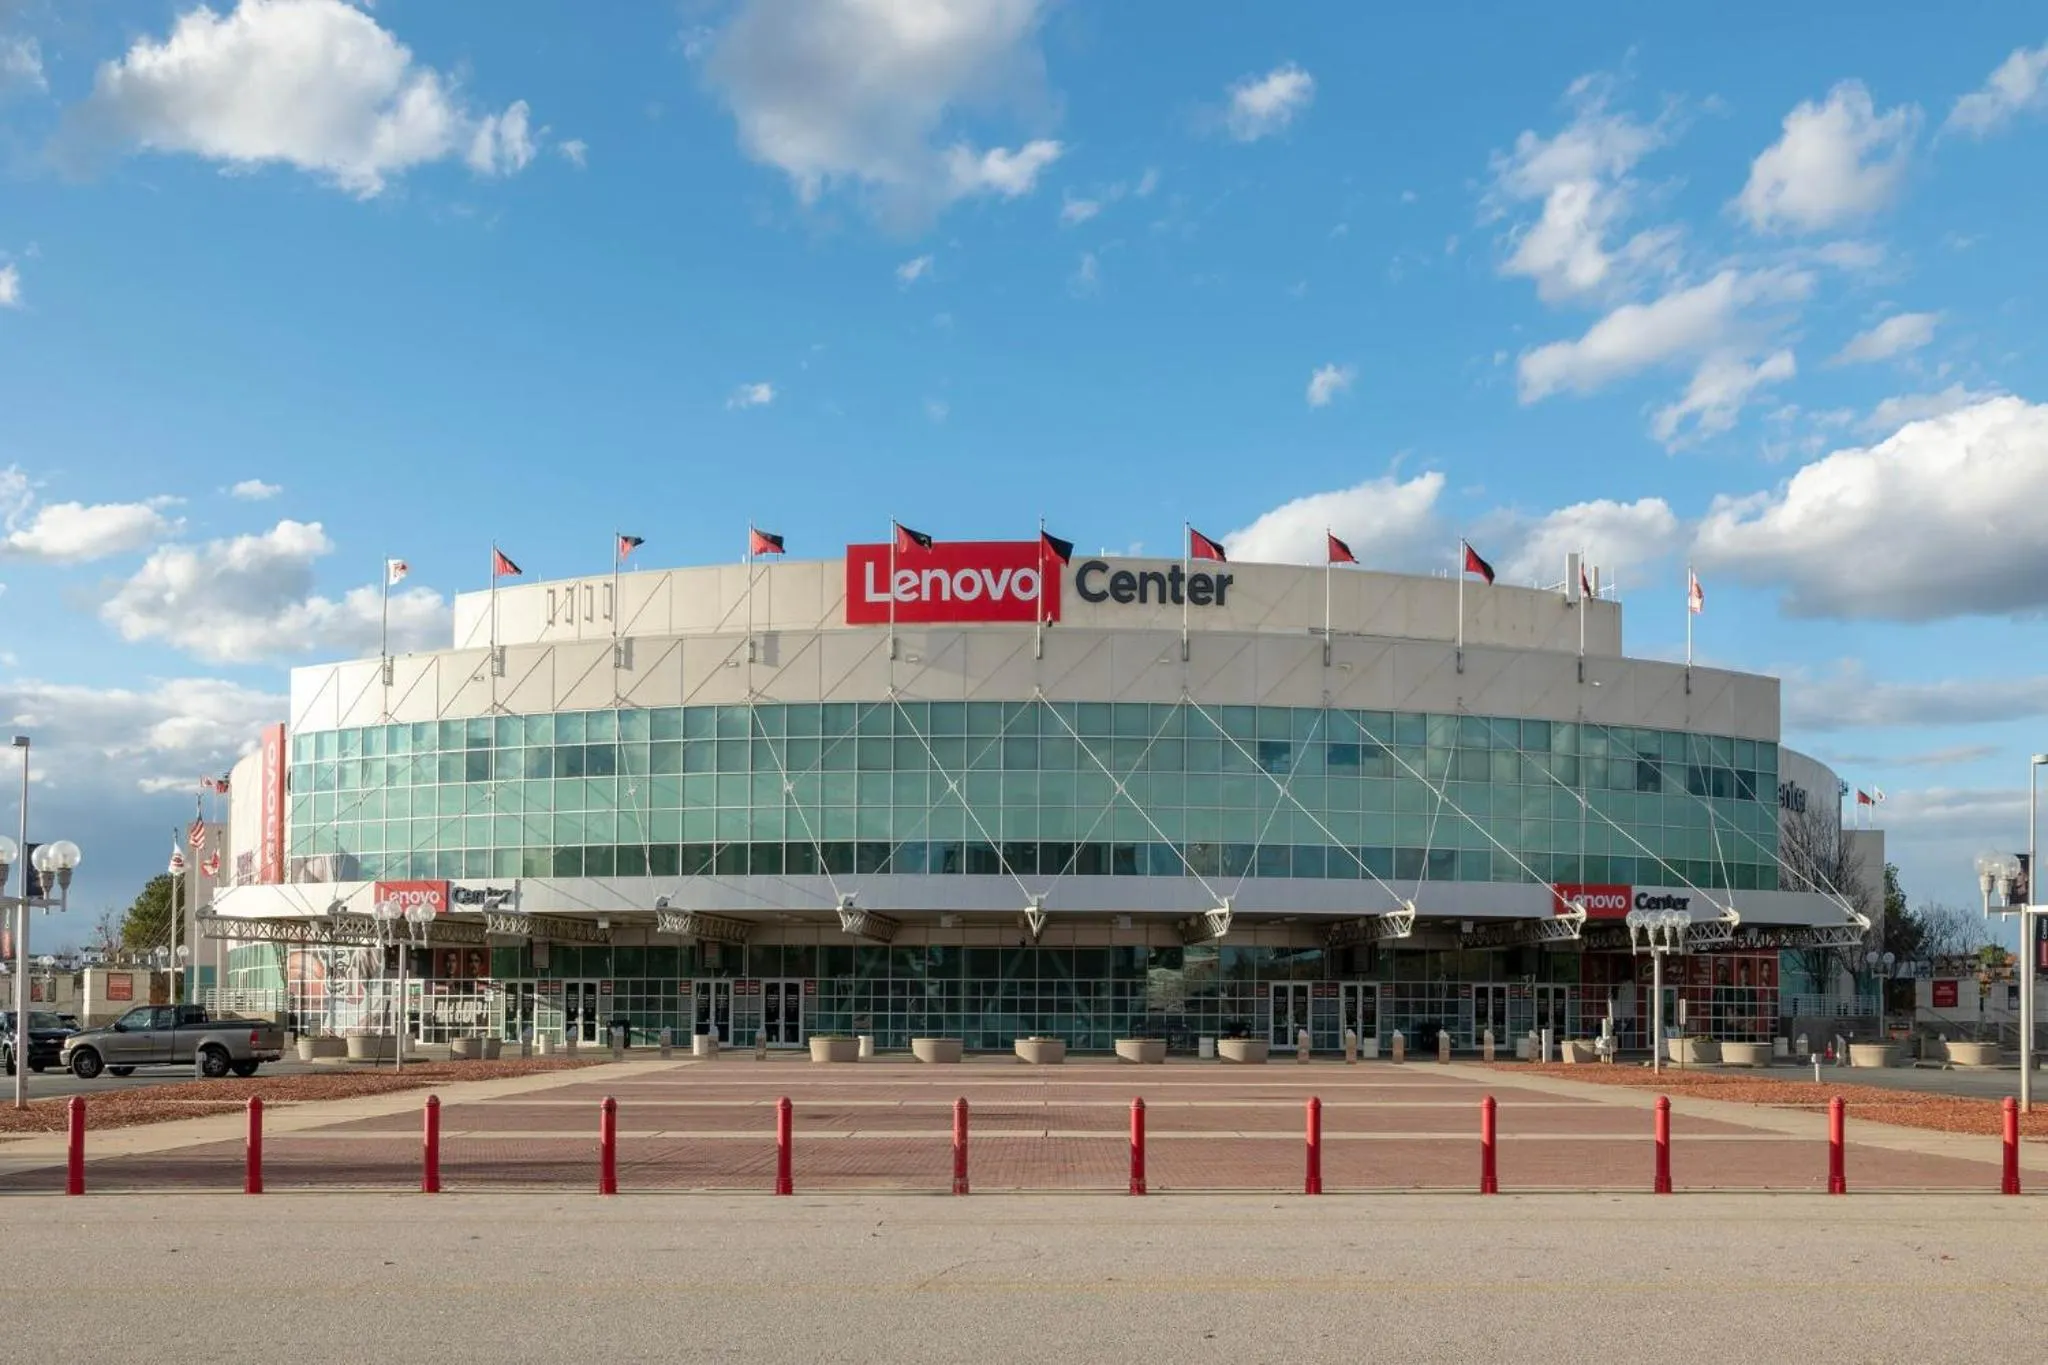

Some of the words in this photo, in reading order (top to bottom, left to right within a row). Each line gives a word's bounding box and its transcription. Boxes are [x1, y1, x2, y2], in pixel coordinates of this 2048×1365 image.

[865, 561, 1040, 603] Lenovo
[1075, 560, 1234, 606] Center
[380, 887, 440, 905] Lenovo
[1562, 890, 1627, 909] Lenovo
[1635, 892, 1691, 910] Center
